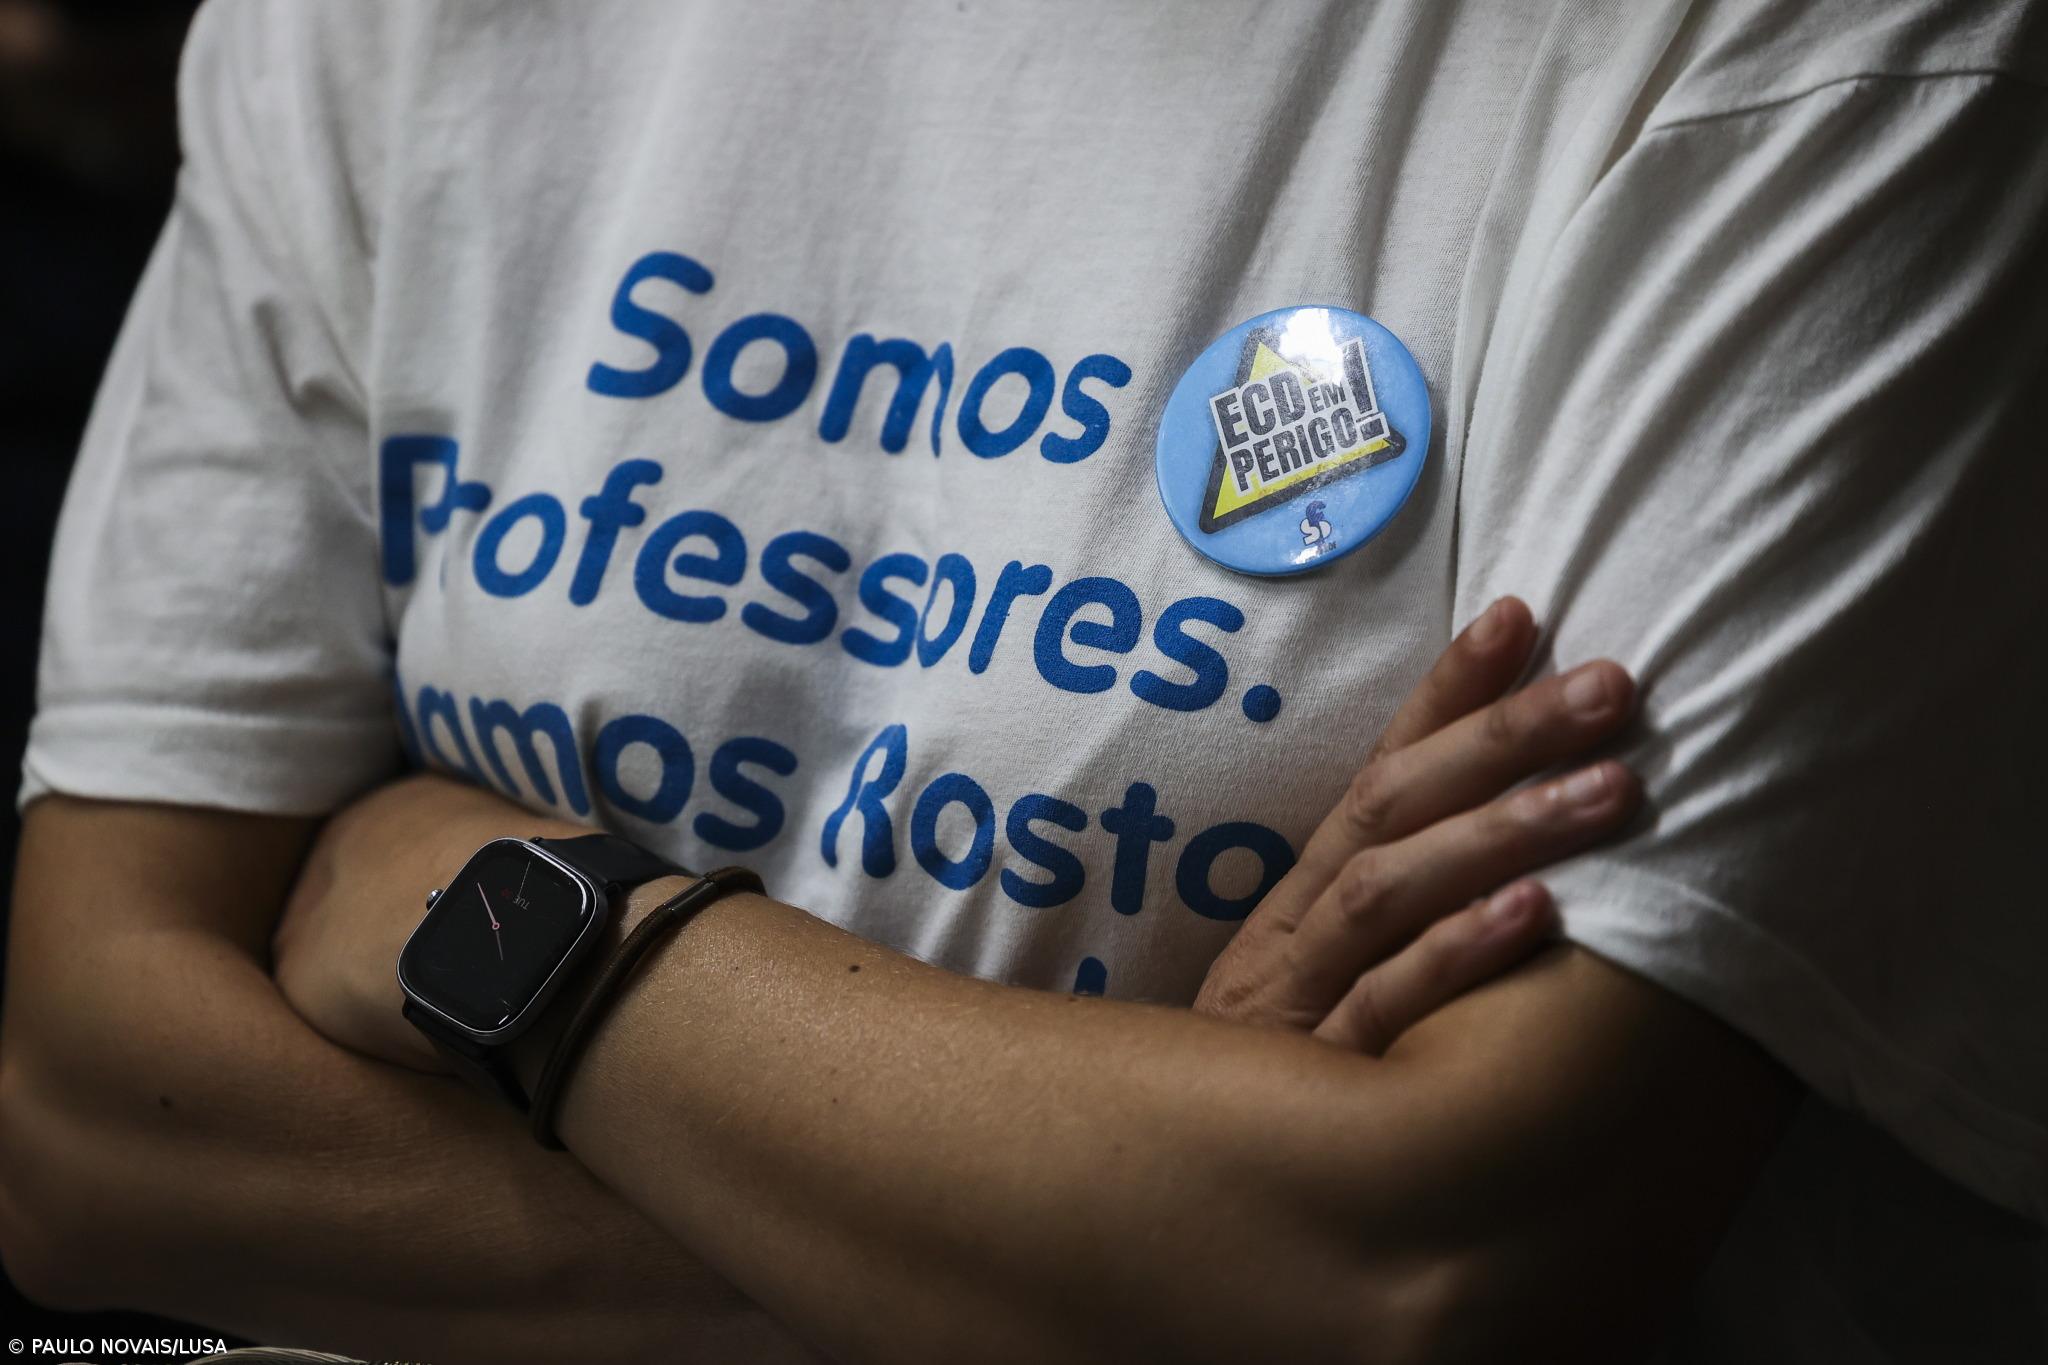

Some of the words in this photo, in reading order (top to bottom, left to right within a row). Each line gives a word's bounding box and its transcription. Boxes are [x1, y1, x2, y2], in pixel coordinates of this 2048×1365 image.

[587, 251, 1133, 464] Somos
[1214, 370, 1306, 449] ECD
[1308, 383, 1347, 413] EM
[391, 650, 798, 852] amos
[820, 723, 1296, 921] Rosto
